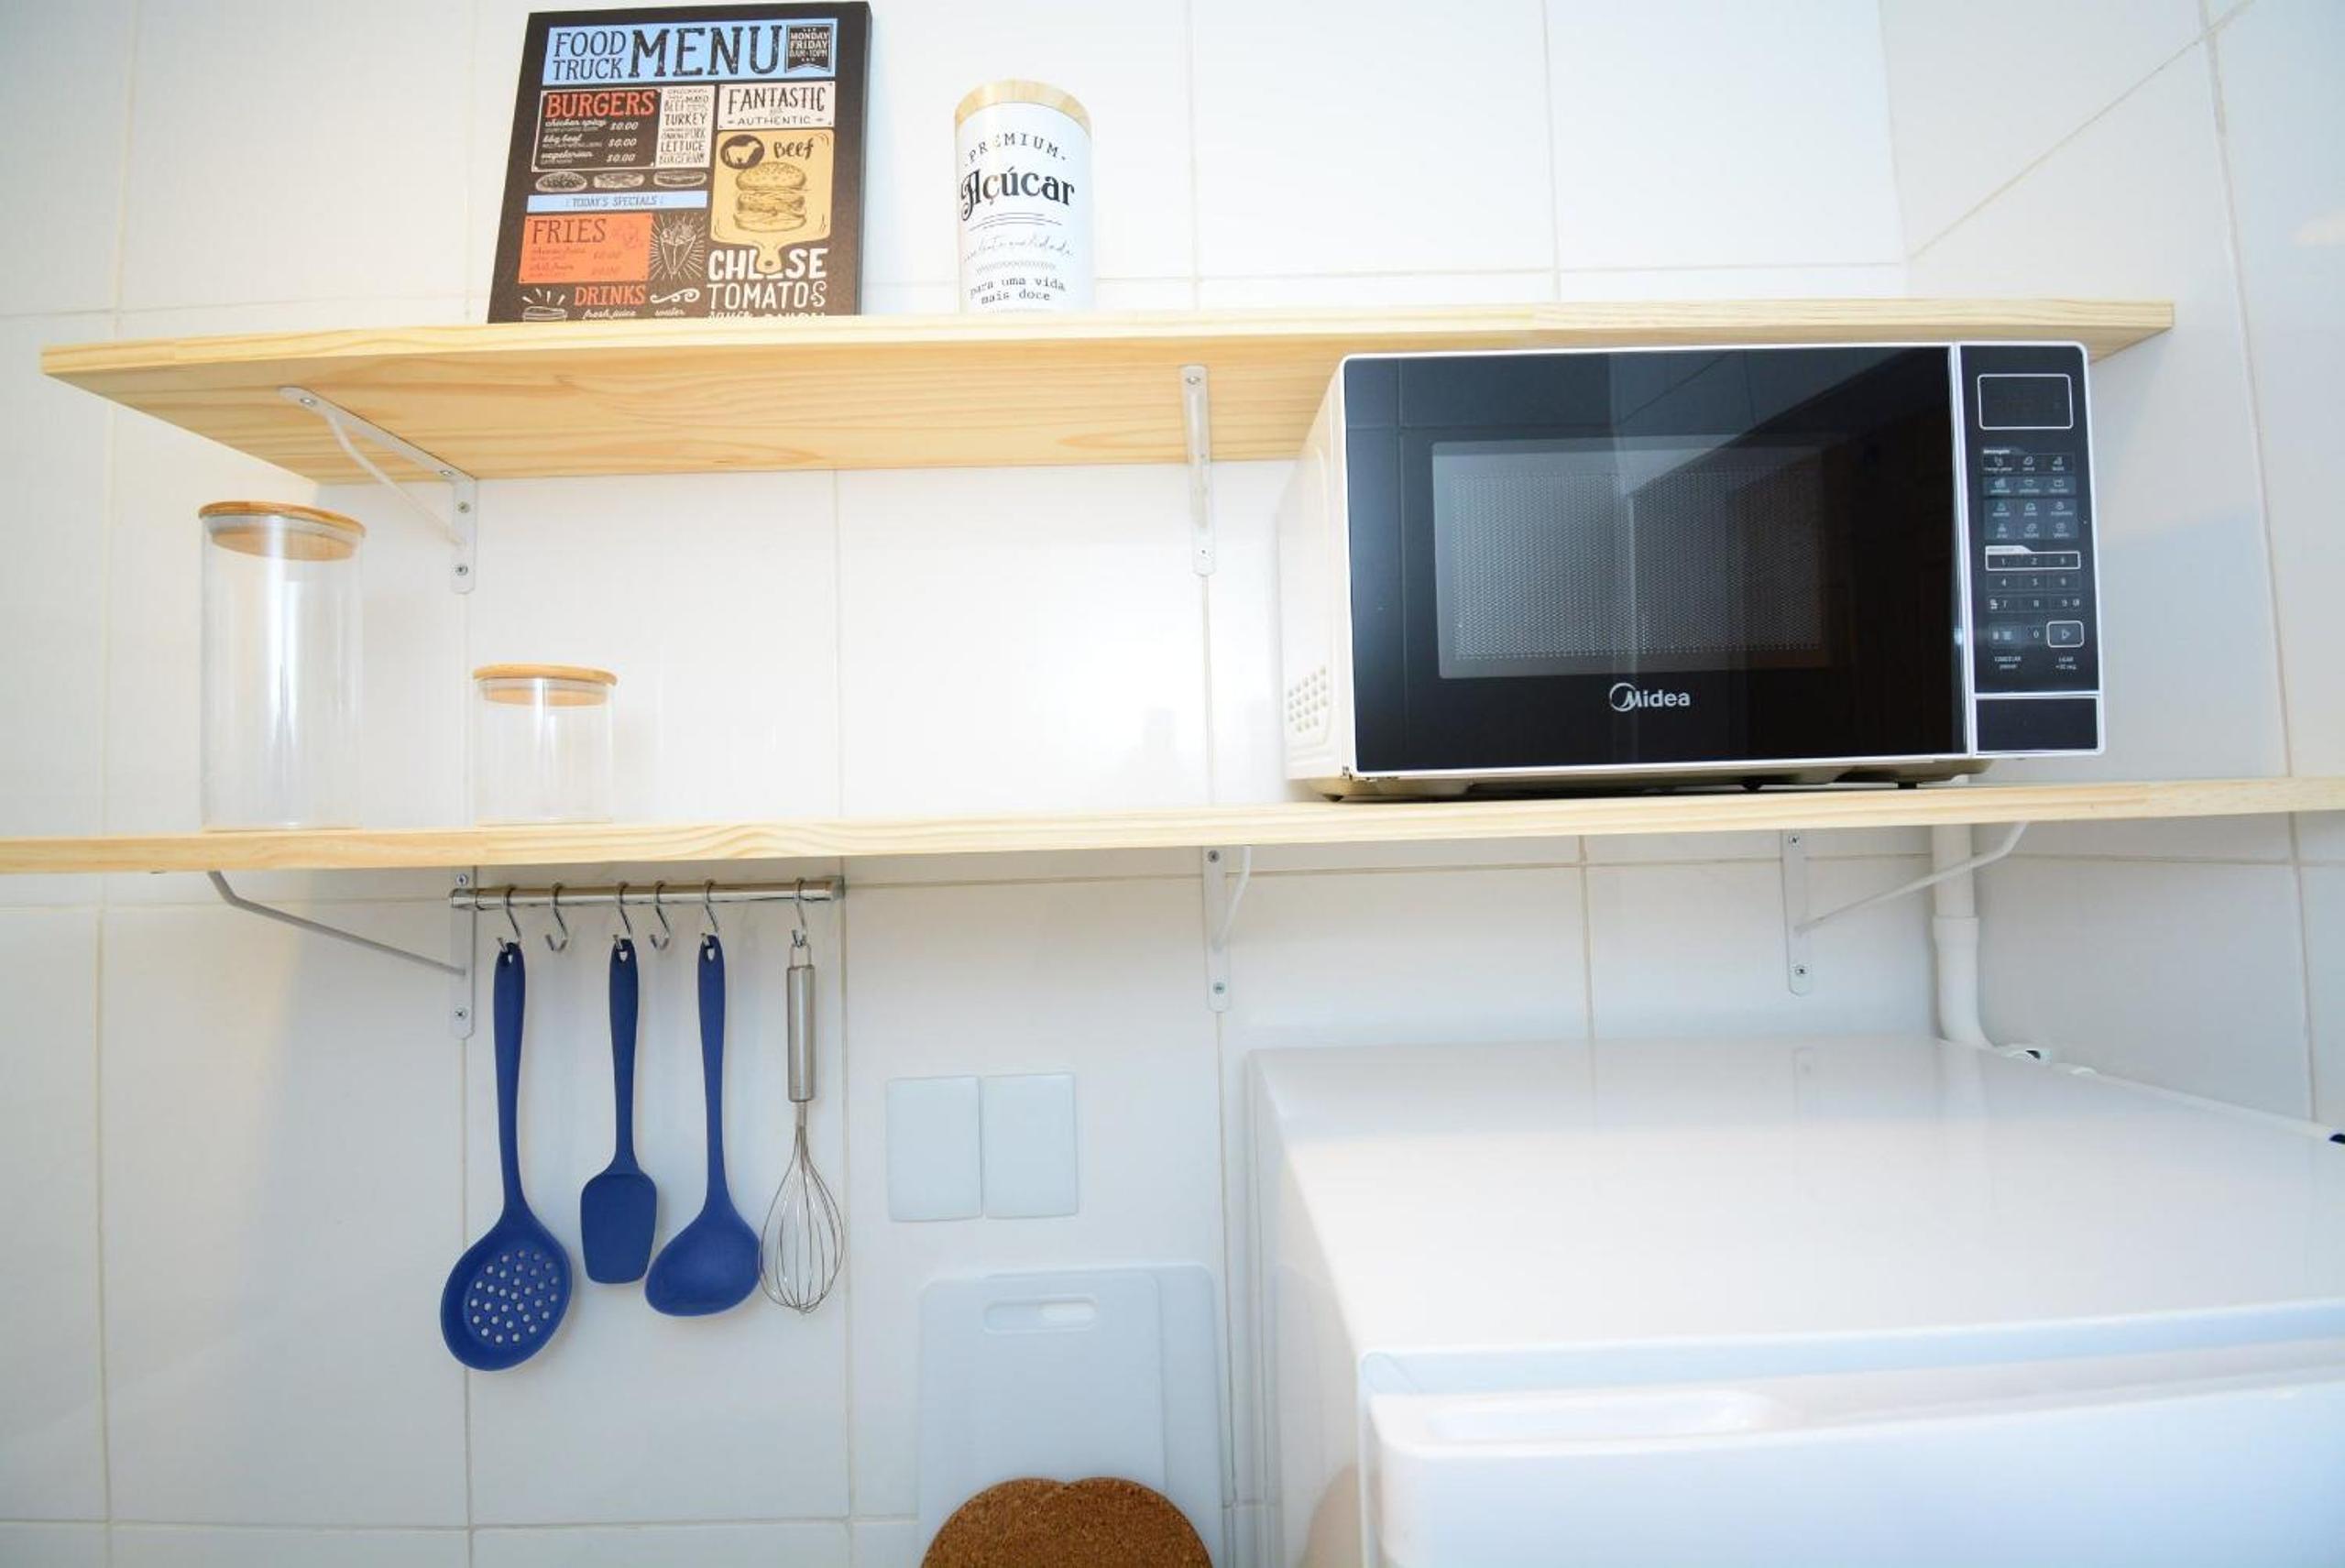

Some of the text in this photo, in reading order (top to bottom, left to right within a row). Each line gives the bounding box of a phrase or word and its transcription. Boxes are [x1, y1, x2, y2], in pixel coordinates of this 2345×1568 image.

[554, 31, 626, 57] FOOD
[628, 24, 782, 78] MENU
[790, 40, 827, 49] FRIDAY
[553, 58, 623, 80] TRUCK
[545, 92, 655, 117] BURGERS
[729, 87, 826, 115] FANTASTIC
[664, 112, 707, 126] TURKEY
[737, 115, 810, 126] AUTHENTIC
[961, 166, 1075, 221] Açúcar
[532, 219, 607, 244] FRIES
[1002, 277, 1026, 286] uma
[1035, 277, 1066, 291] vida
[1018, 289, 1050, 301] doce
[574, 286, 646, 306] DRINKS
[1609, 682, 1691, 712] Midea
